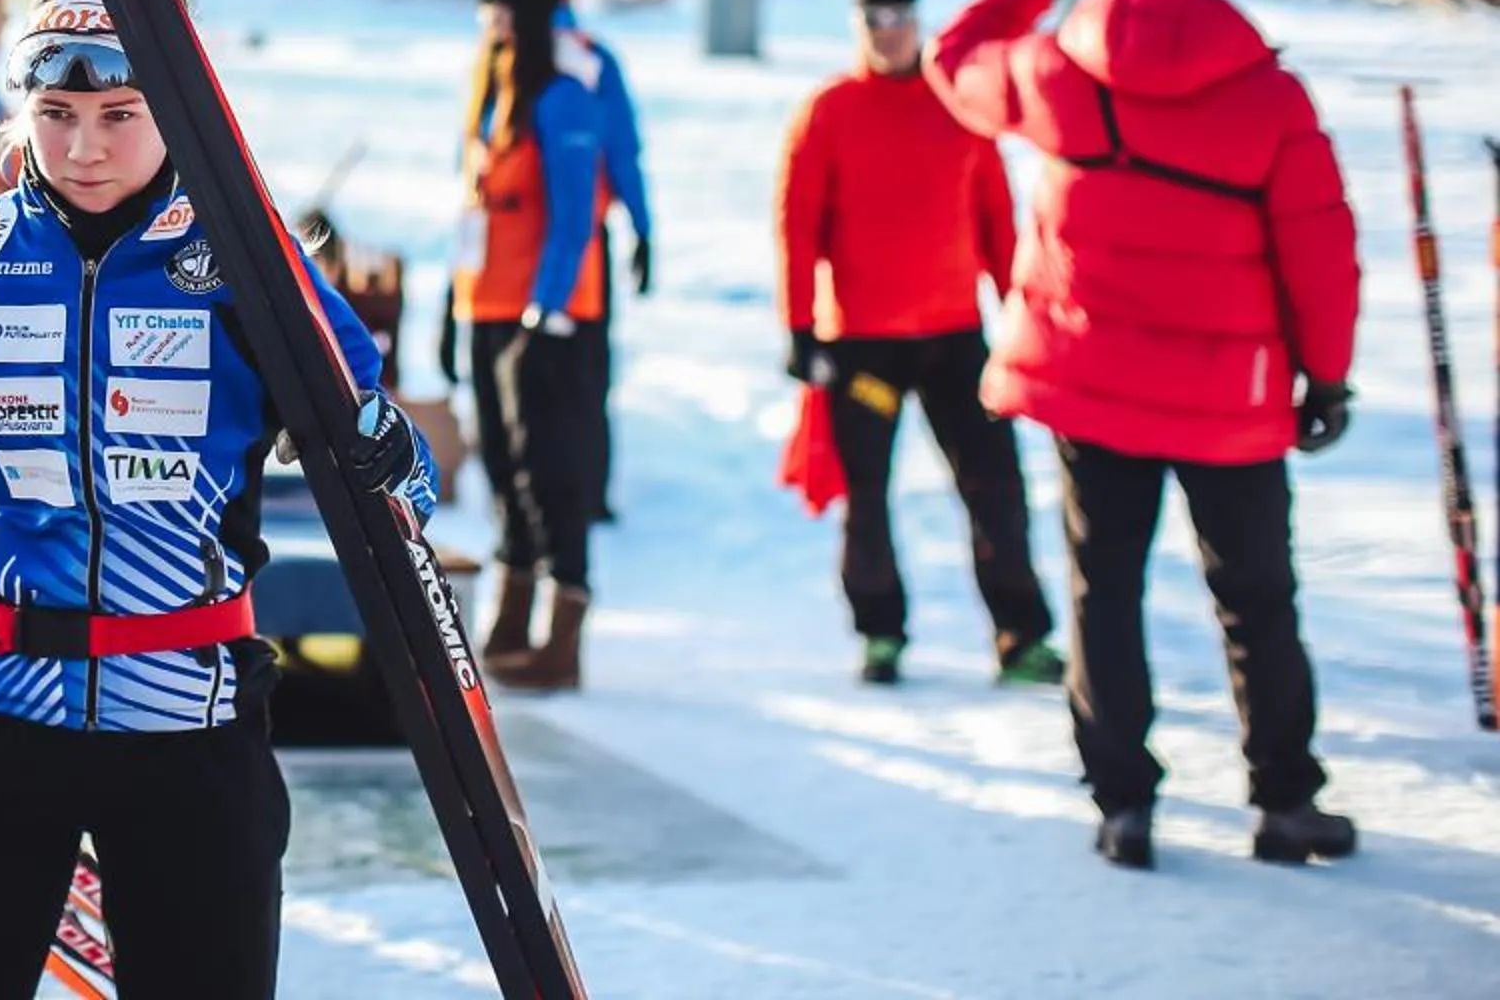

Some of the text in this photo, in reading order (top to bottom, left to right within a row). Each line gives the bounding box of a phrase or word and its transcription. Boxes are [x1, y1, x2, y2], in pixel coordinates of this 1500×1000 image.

[115, 314, 205, 329] YIT Chalets
[405, 539, 476, 690] ATOMIC
